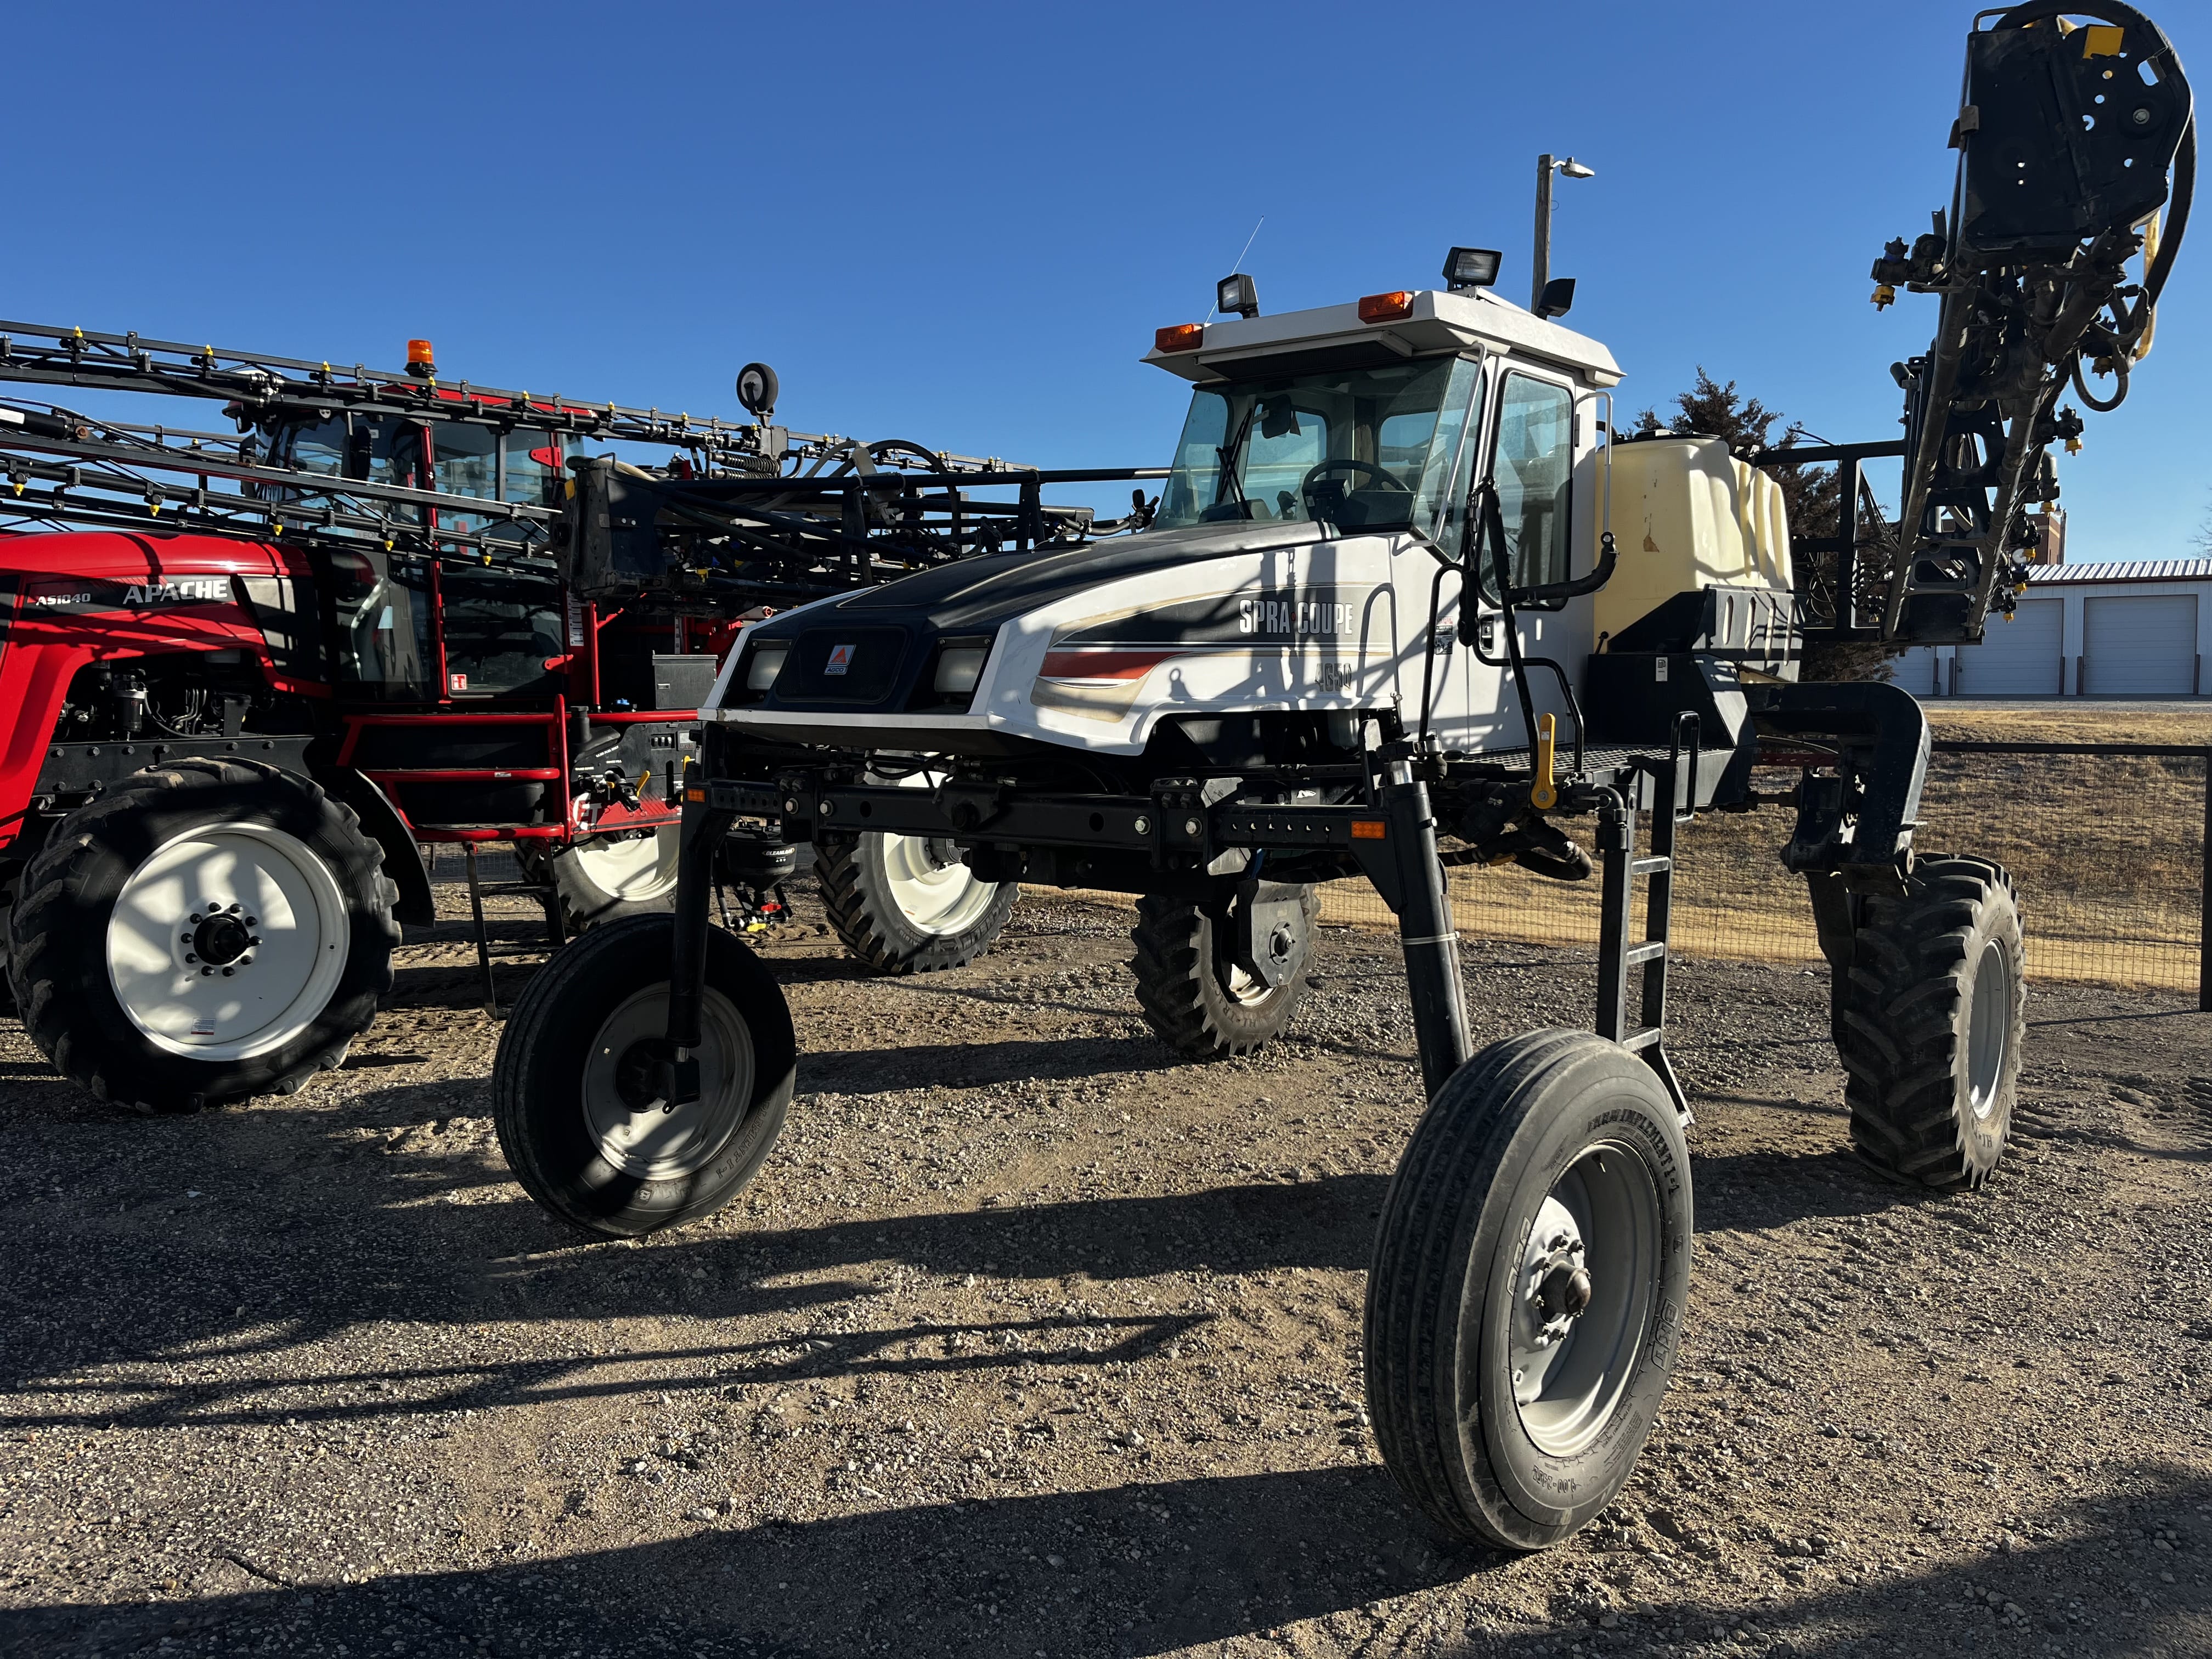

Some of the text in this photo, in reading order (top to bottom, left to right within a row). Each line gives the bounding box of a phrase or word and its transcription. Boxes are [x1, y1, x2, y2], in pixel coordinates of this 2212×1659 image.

[36, 593, 91, 606] AS1040
[123, 579, 228, 604] APACHE
[1621, 1109, 1673, 1166] IMPLEMENT
